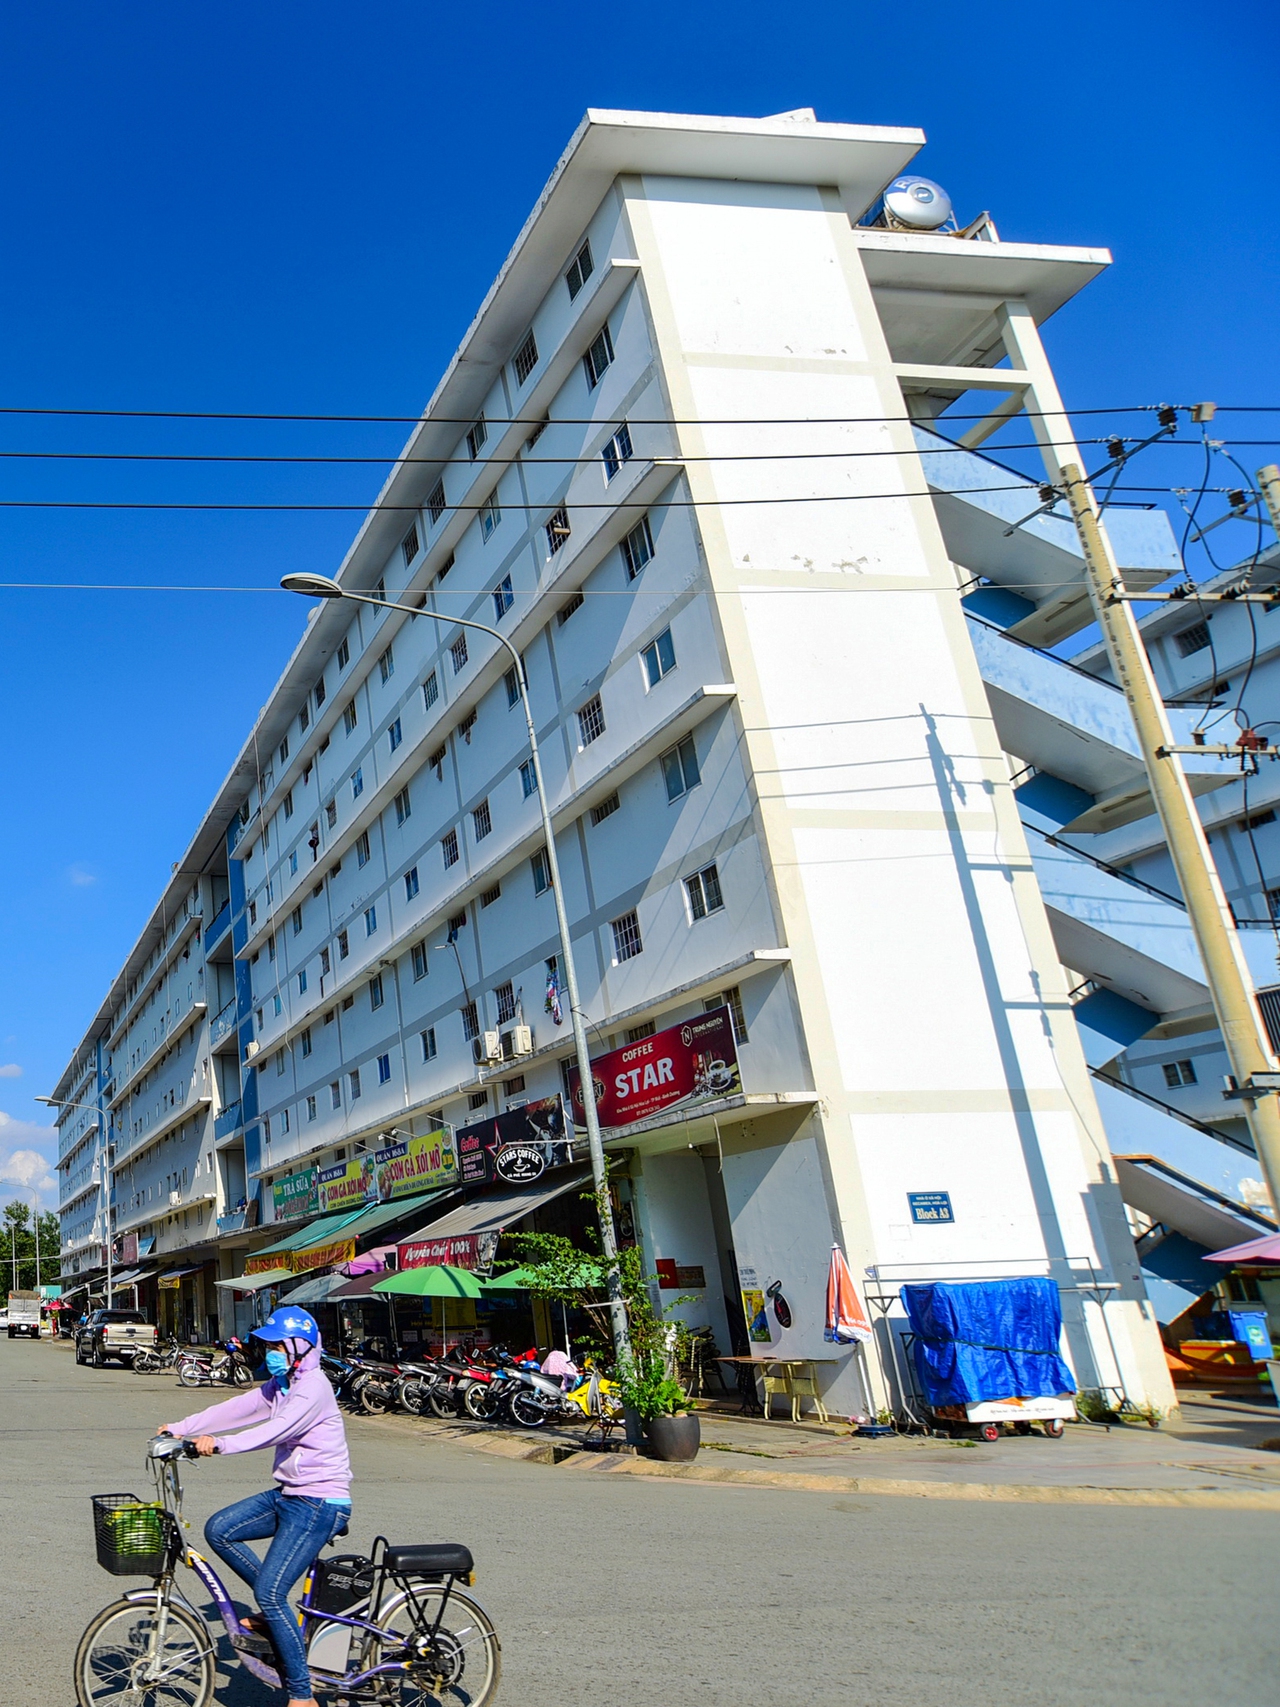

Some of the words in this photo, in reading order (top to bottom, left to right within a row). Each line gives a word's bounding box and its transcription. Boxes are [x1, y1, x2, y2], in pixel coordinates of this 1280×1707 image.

[622, 1042, 654, 1062] COFFEE
[615, 1058, 675, 1098] STAR
[460, 1135, 479, 1152] Coffee
[377, 1150, 391, 1162] QUÁN
[390, 1158, 404, 1181] CƠM
[405, 1152, 415, 1177] GÀ
[416, 1144, 428, 1175] XỐI
[500, 1150, 516, 1167] STARS
[518, 1149, 540, 1164] COFFEE
[283, 1178, 295, 1196] TRÀ
[296, 1175, 309, 1192] SỮA
[328, 1184, 338, 1201] CƠM
[339, 1181, 348, 1198] GÀ
[915, 1207, 939, 1219] Block
[940, 1207, 950, 1219] A3
[405, 1246, 430, 1261] Nguyên
[451, 1240, 470, 1255] 100%
[190, 1554, 226, 1602] ASAMA
